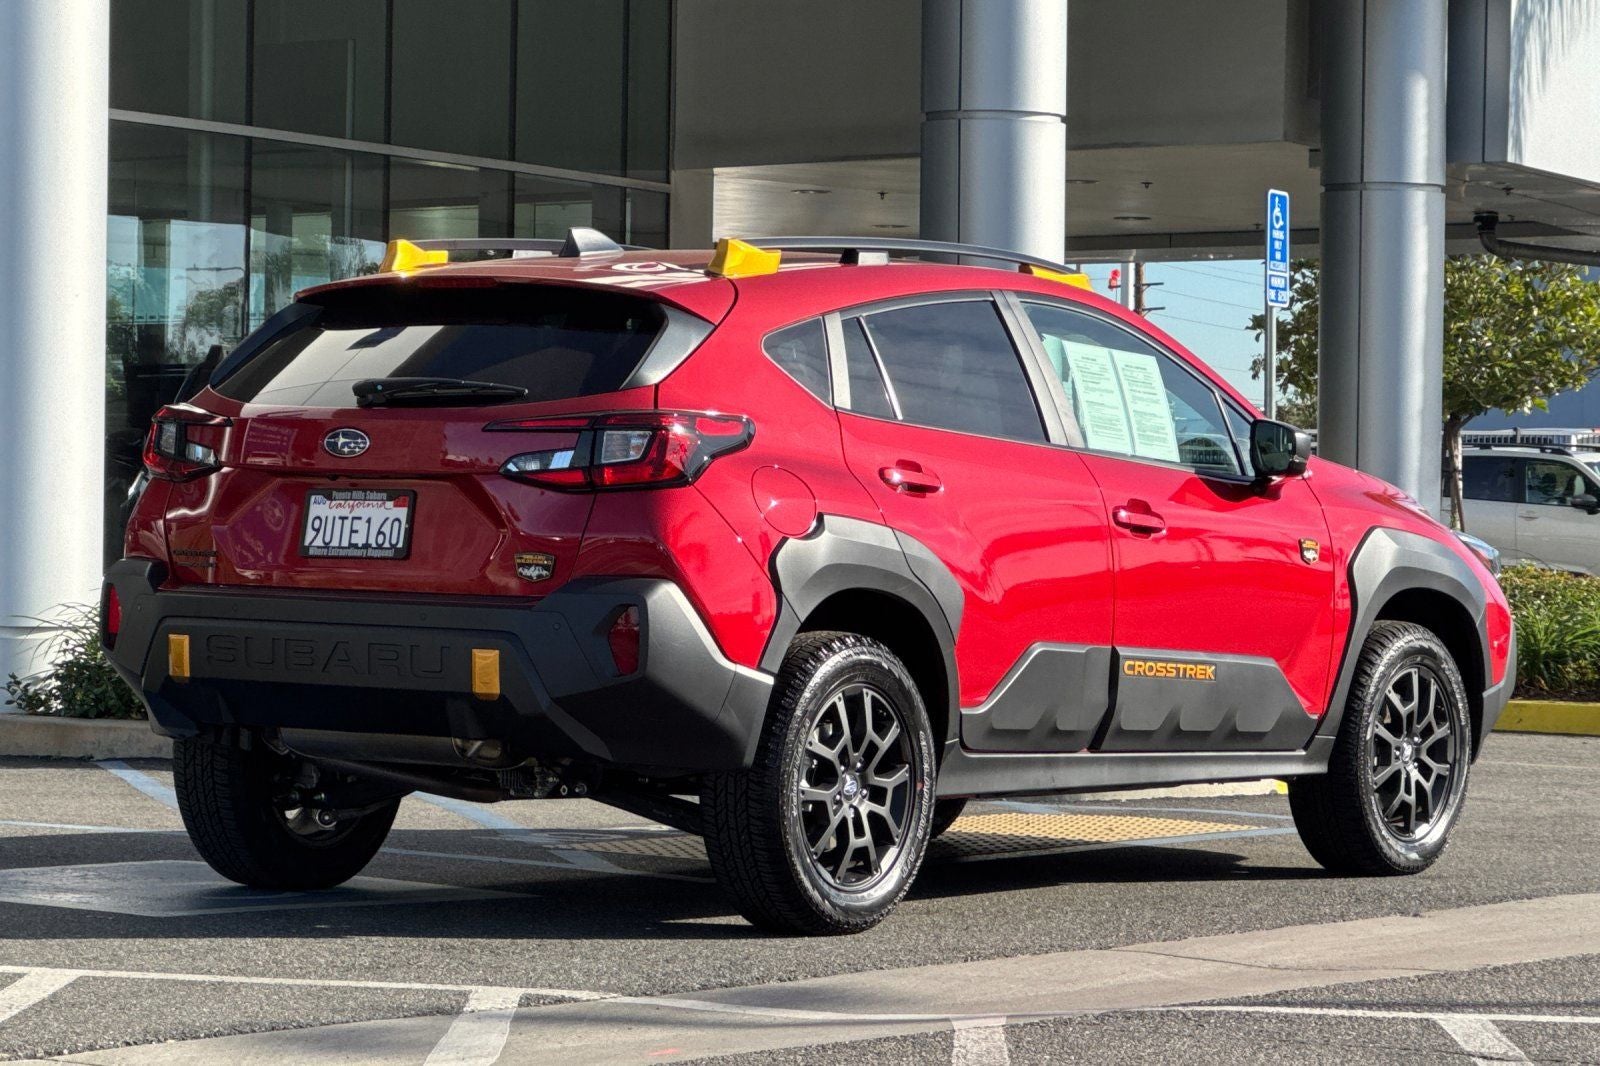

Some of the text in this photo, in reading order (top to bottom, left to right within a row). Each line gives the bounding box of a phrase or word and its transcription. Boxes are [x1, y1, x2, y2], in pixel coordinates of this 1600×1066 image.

[328, 500, 392, 514] California
[308, 515, 402, 548] 9UTE160
[205, 634, 450, 679] SUBARU
[1123, 660, 1216, 680] CROSSTREK
